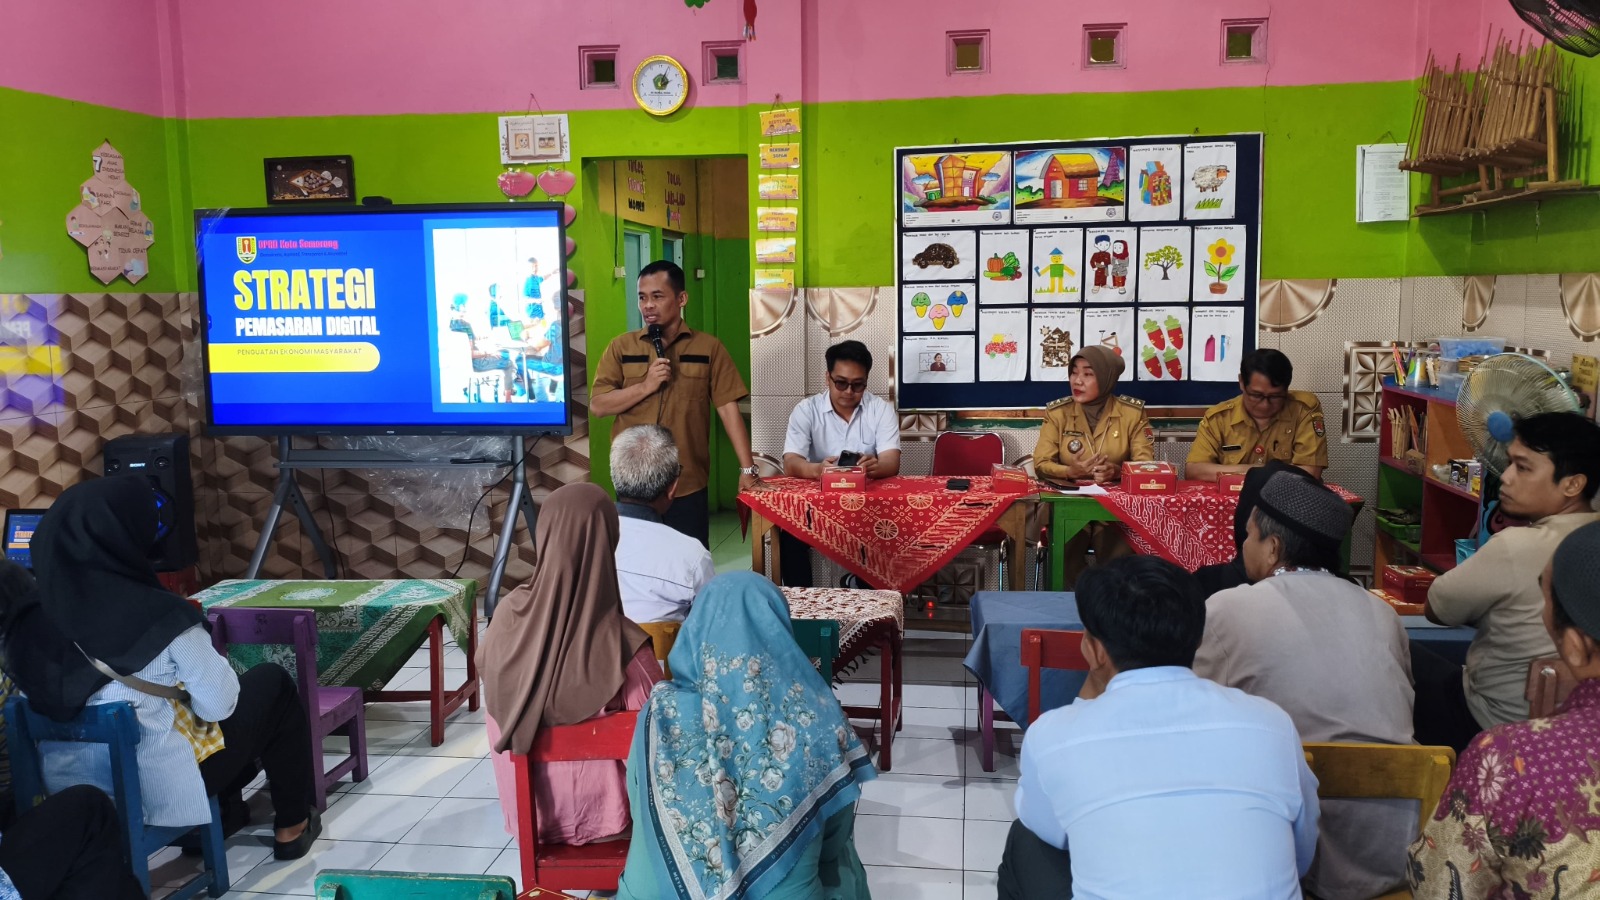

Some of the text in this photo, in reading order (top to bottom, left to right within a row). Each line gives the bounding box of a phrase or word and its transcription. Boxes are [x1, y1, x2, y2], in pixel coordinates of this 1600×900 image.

[93, 156, 103, 173] 7
[233, 268, 376, 310] STRATEGI
[235, 316, 380, 336] PEMASARAN DIGITAL
